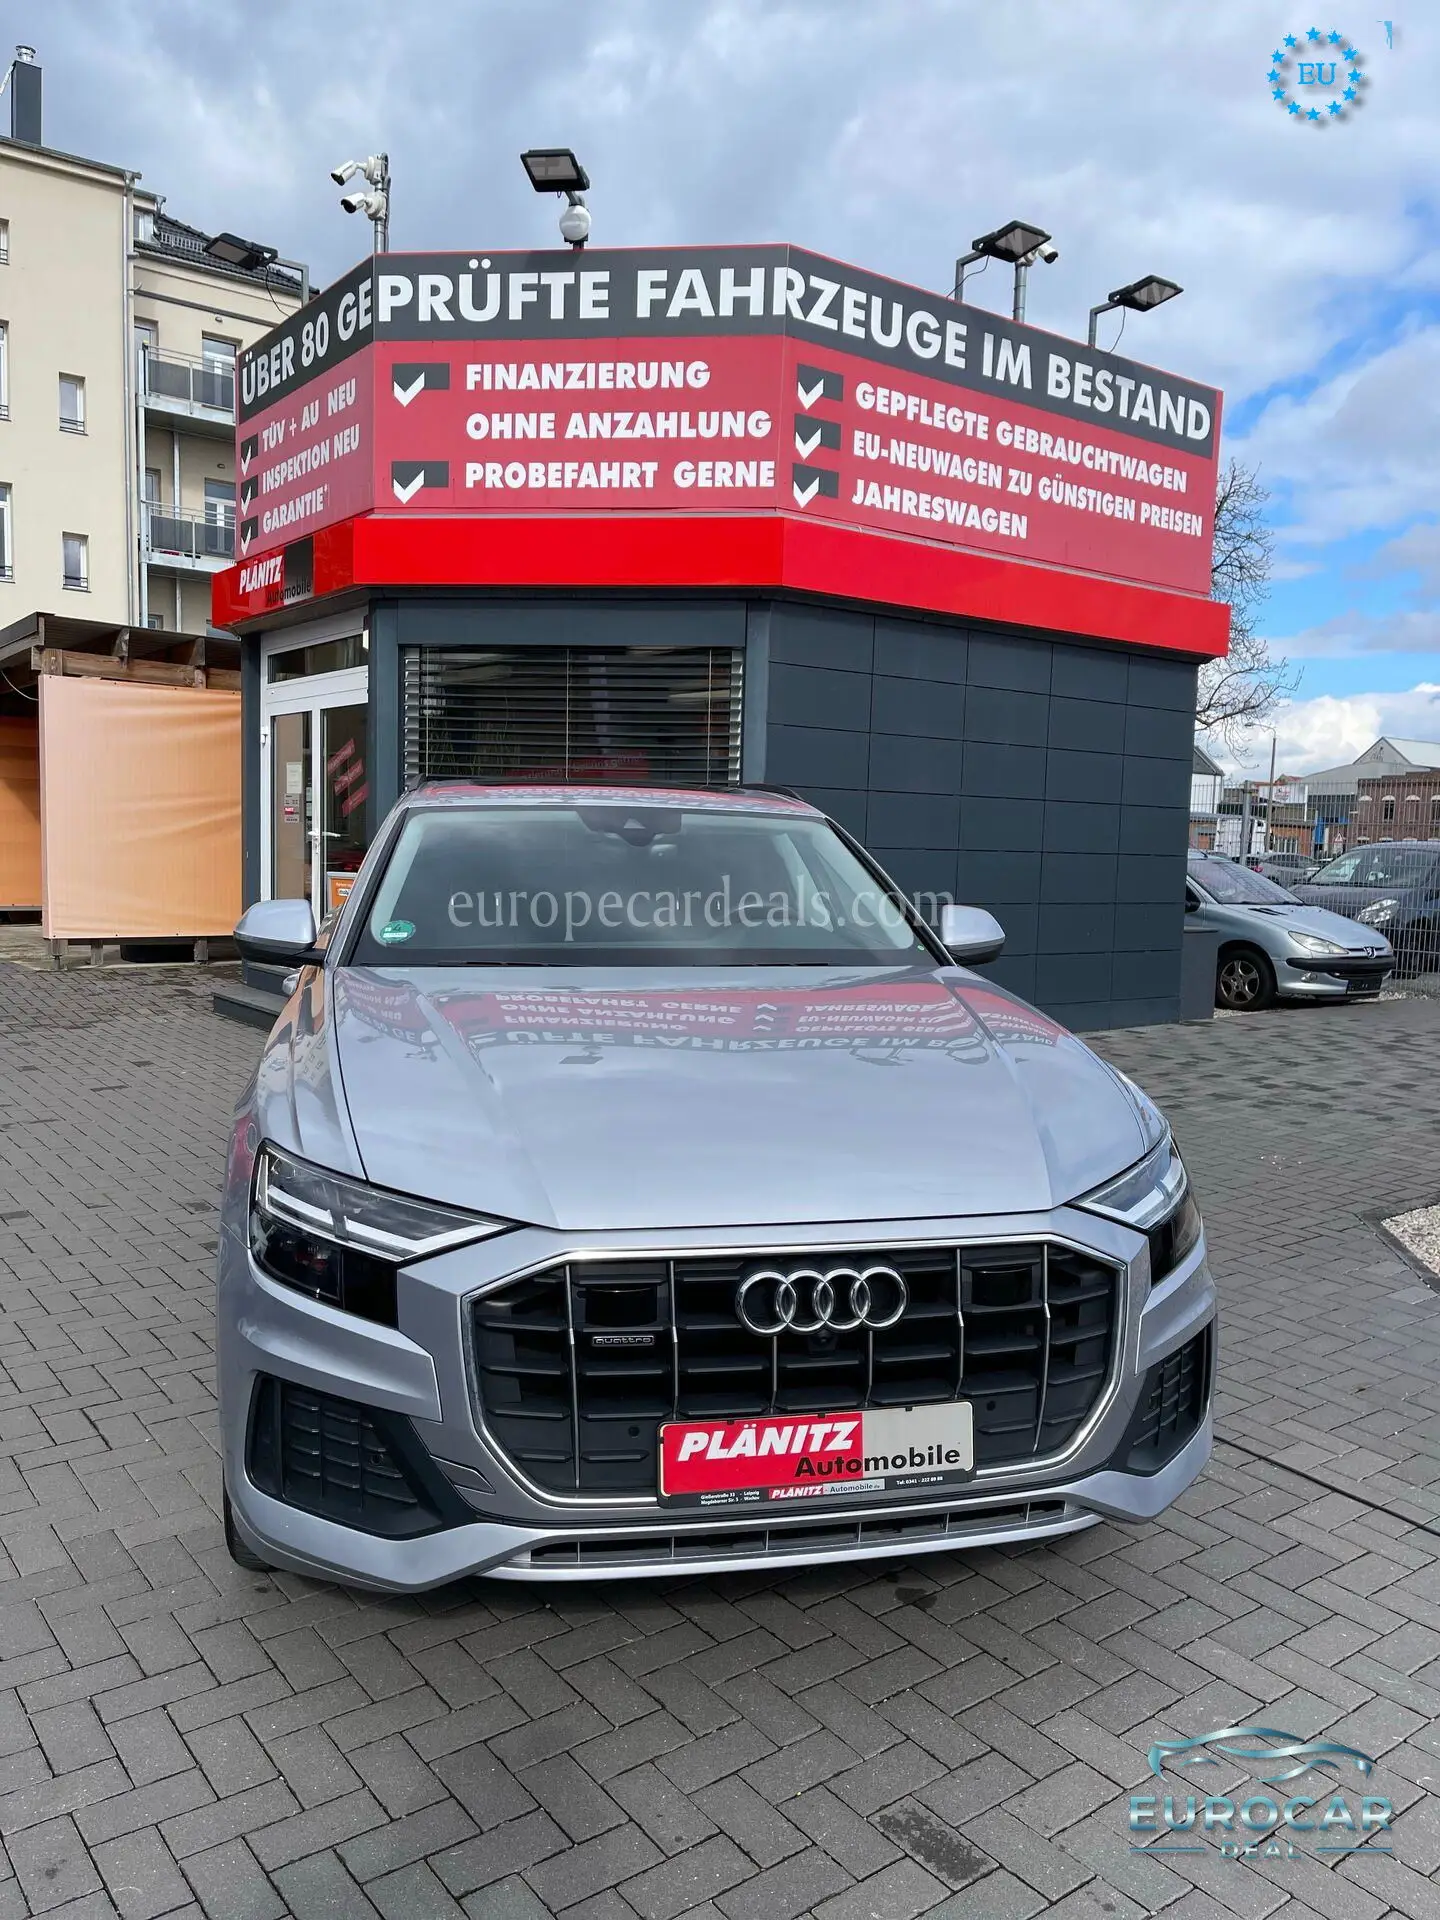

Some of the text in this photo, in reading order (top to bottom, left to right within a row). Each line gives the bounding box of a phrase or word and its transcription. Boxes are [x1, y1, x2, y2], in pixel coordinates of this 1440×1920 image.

[241, 335, 295, 405] ÜBER
[301, 311, 329, 368] 80
[636, 266, 967, 369] FAHRZEUGE
[982, 331, 1033, 390] IM
[1047, 352, 1211, 442] BESTAND
[466, 361, 711, 391] FINANZIERUNG
[262, 420, 285, 453] TÜV
[301, 404, 319, 432] AU
[327, 377, 356, 415] NEU
[466, 410, 772, 440] OHNE ANZAHLUNG
[855, 382, 1188, 494] GEPFLEGTE GEBRAUCHTWAGEN
[262, 424, 360, 495] INSPEKTION NEU
[465, 461, 776, 489] PROBEFAHRT GERNE
[853, 429, 1203, 537] EU-NEUWAGEN ZU GÜNSTIGEN PREISEN
[852, 478, 1028, 539] JAHRESWAGEN
[239, 554, 283, 596] PLÄNITZ
[595, 1336, 652, 1345] quattro
[677, 1420, 860, 1462] PLÄNITZ
[794, 1444, 961, 1477] Automobile
[771, 1485, 823, 1499] PLÄNITZ
